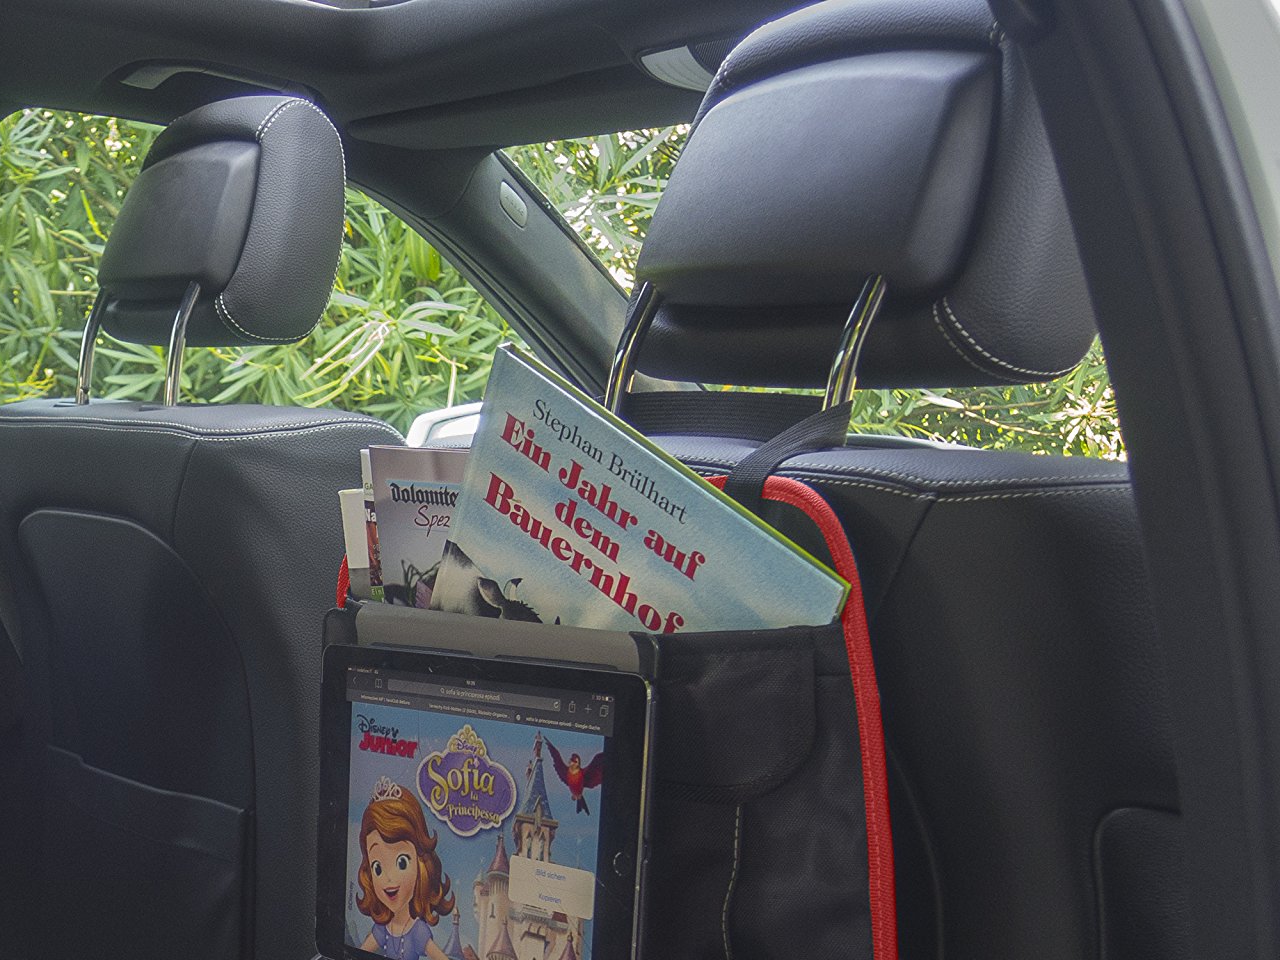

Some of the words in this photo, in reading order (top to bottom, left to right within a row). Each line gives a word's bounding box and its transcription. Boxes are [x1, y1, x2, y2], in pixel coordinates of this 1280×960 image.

[532, 399, 603, 464] Stephan
[607, 452, 688, 525] Brülhart
[499, 411, 552, 473] Ein
[558, 458, 638, 531] Jahr
[643, 529, 706, 581] auf
[483, 472, 685, 634] Bauernhof
[554, 498, 621, 564] dem
[356, 714, 392, 740] Disney
[427, 755, 495, 811] Sofia
[447, 803, 501, 824] Principessa
[470, 791, 479, 801] la
